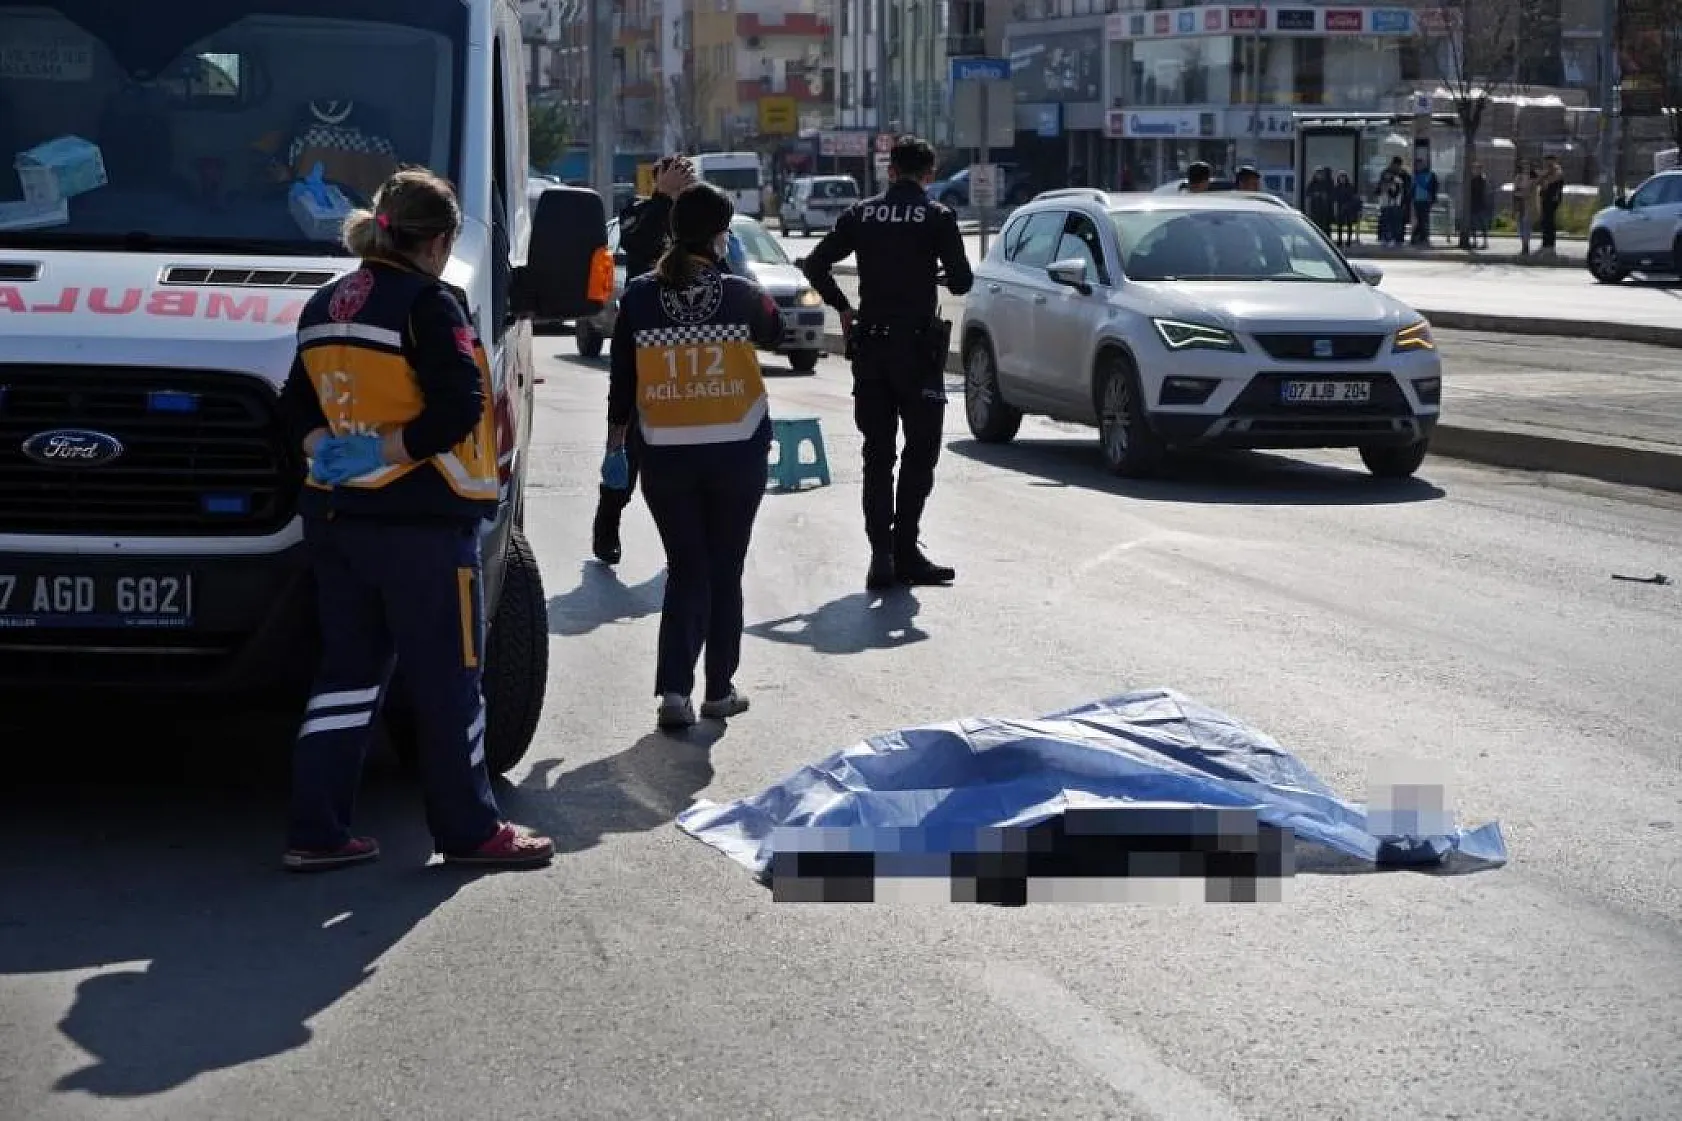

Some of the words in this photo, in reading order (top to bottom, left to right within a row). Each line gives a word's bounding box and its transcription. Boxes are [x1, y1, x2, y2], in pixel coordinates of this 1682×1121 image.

[664, 346, 724, 377] 112
[44, 436, 98, 458] Ford
[33, 576, 94, 612] AGD
[117, 576, 180, 612] 682
